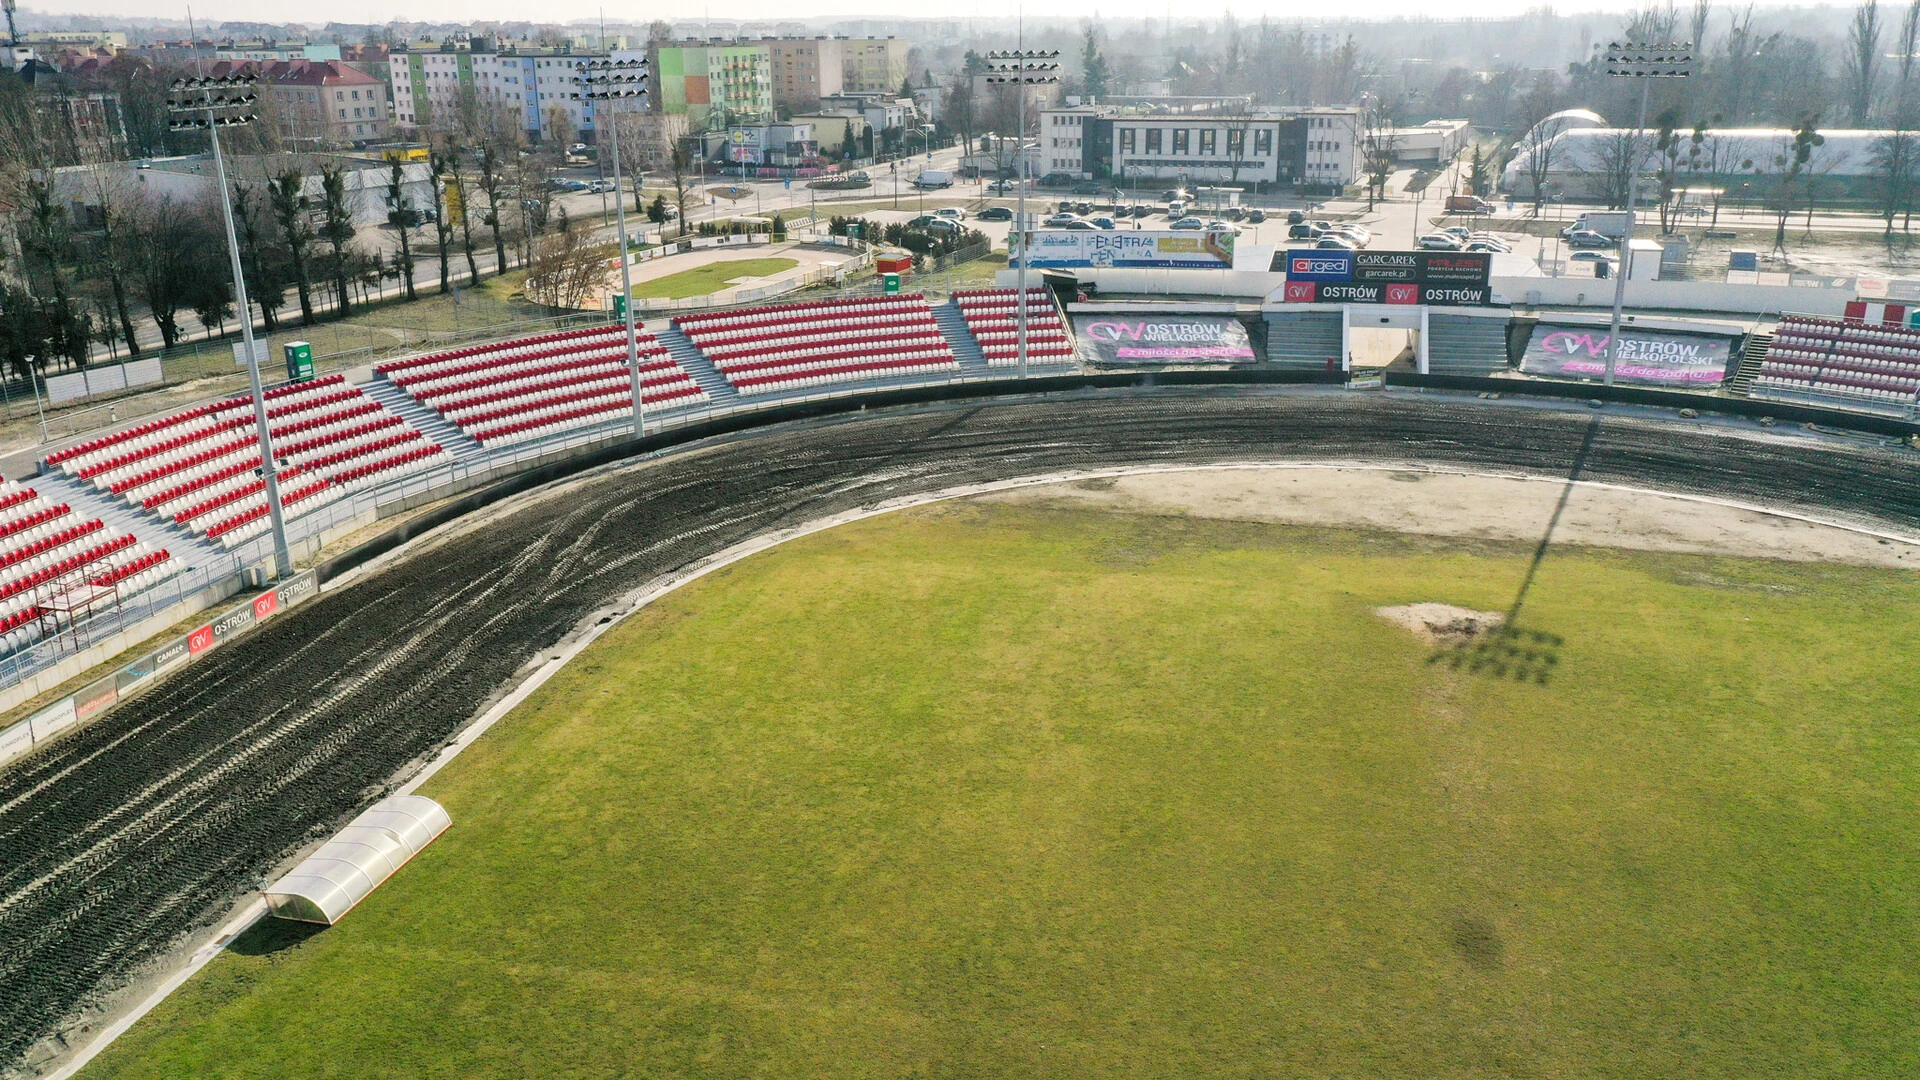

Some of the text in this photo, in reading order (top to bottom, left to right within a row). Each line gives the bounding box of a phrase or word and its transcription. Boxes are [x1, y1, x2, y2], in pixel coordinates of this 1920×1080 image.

[1297, 260, 1345, 273] arged
[1357, 254, 1417, 265] GARCAREK
[1365, 270, 1407, 278] garcarek.pl
[1322, 284, 1378, 298] OSTRÓW
[1425, 287, 1482, 301] OSTRÓW
[1146, 321, 1221, 335] OSTRÓW
[1182, 348, 1196, 356] do
[1636, 366, 1655, 376] do
[1658, 369, 1709, 379] sportu!
[278, 576, 312, 601] OSTRÓW
[214, 608, 251, 636] OSTRÓW
[157, 644, 184, 664] CANAL+
